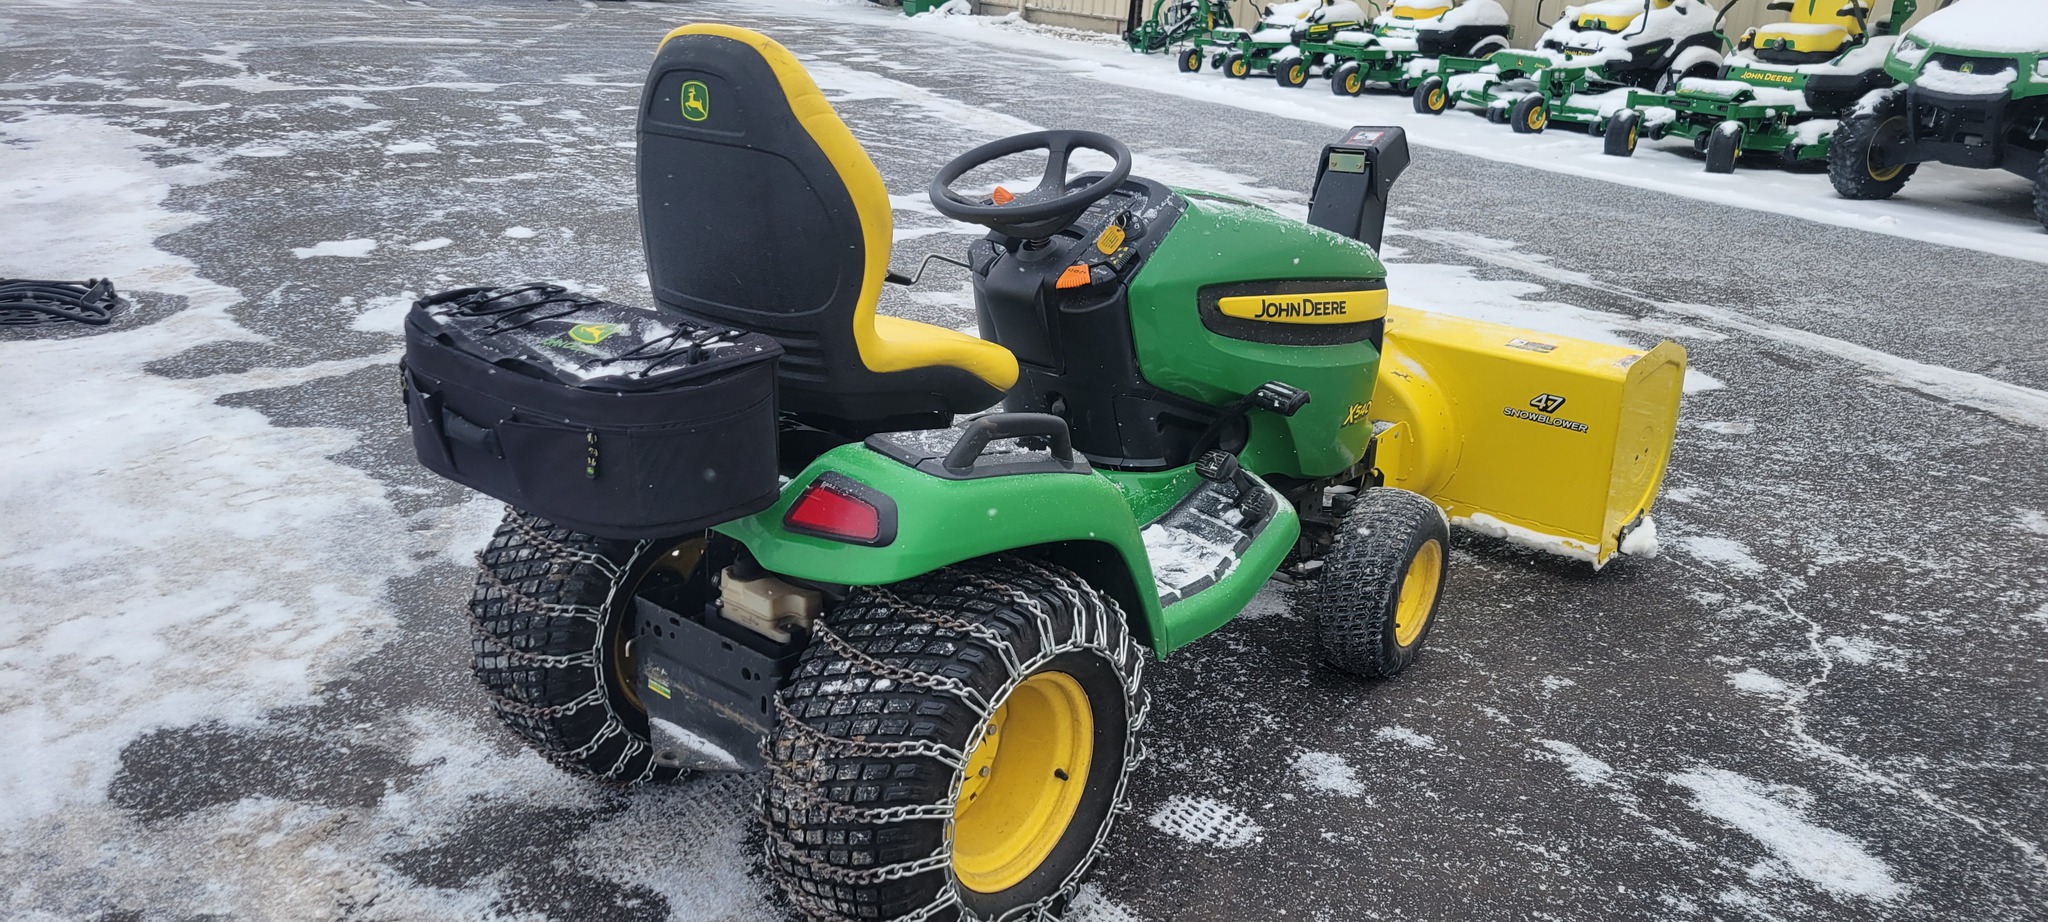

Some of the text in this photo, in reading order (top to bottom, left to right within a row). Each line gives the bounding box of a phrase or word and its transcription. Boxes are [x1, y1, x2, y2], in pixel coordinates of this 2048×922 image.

[1741, 71, 1794, 83] JOHN DEERE
[1254, 298, 1347, 318] JOHN DEERE
[1529, 393, 1566, 414] 47
[1503, 407, 1589, 433] SNOWBLOWER
